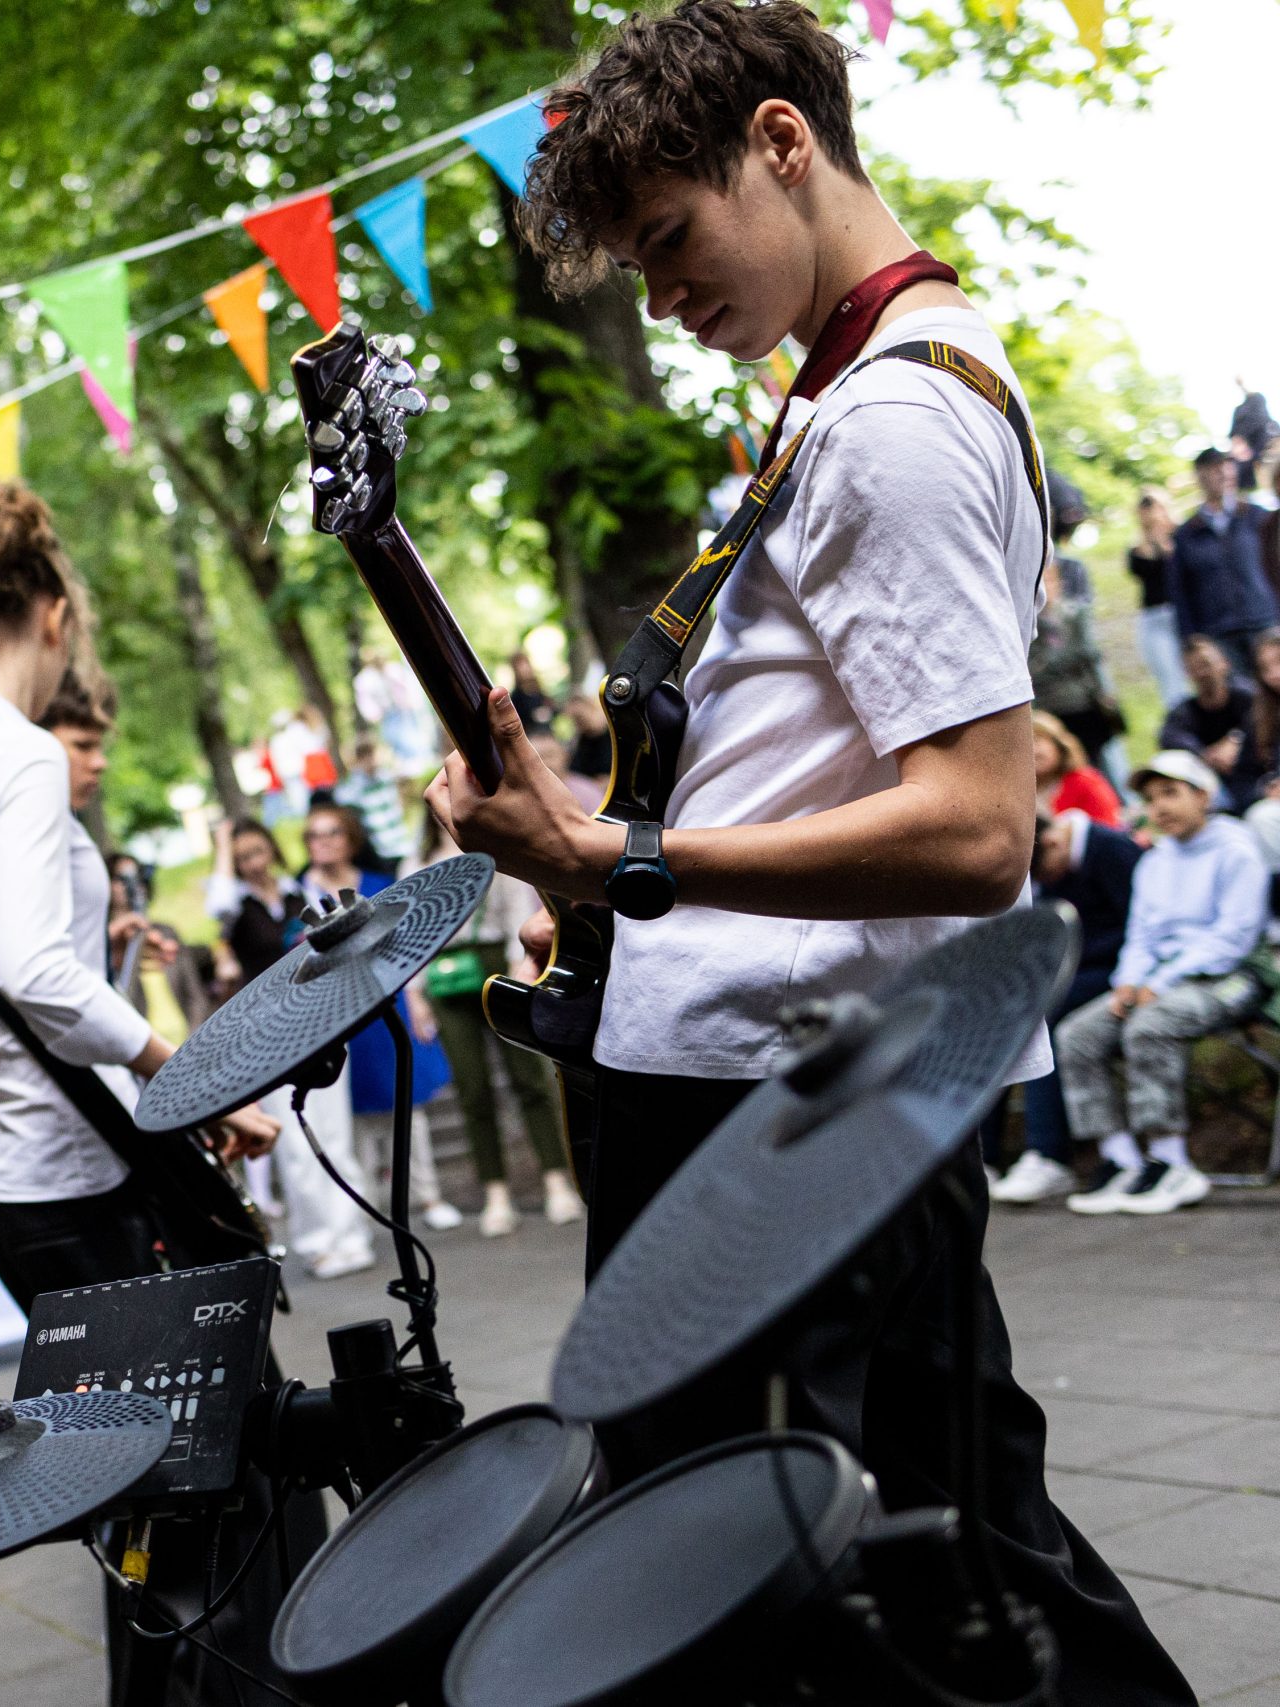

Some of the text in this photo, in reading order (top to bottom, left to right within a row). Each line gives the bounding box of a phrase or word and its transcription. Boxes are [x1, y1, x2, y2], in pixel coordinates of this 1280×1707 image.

[193, 1299, 249, 1322] DTX
[198, 1316, 241, 1328] drums
[48, 1323, 87, 1343] YAMAHA
